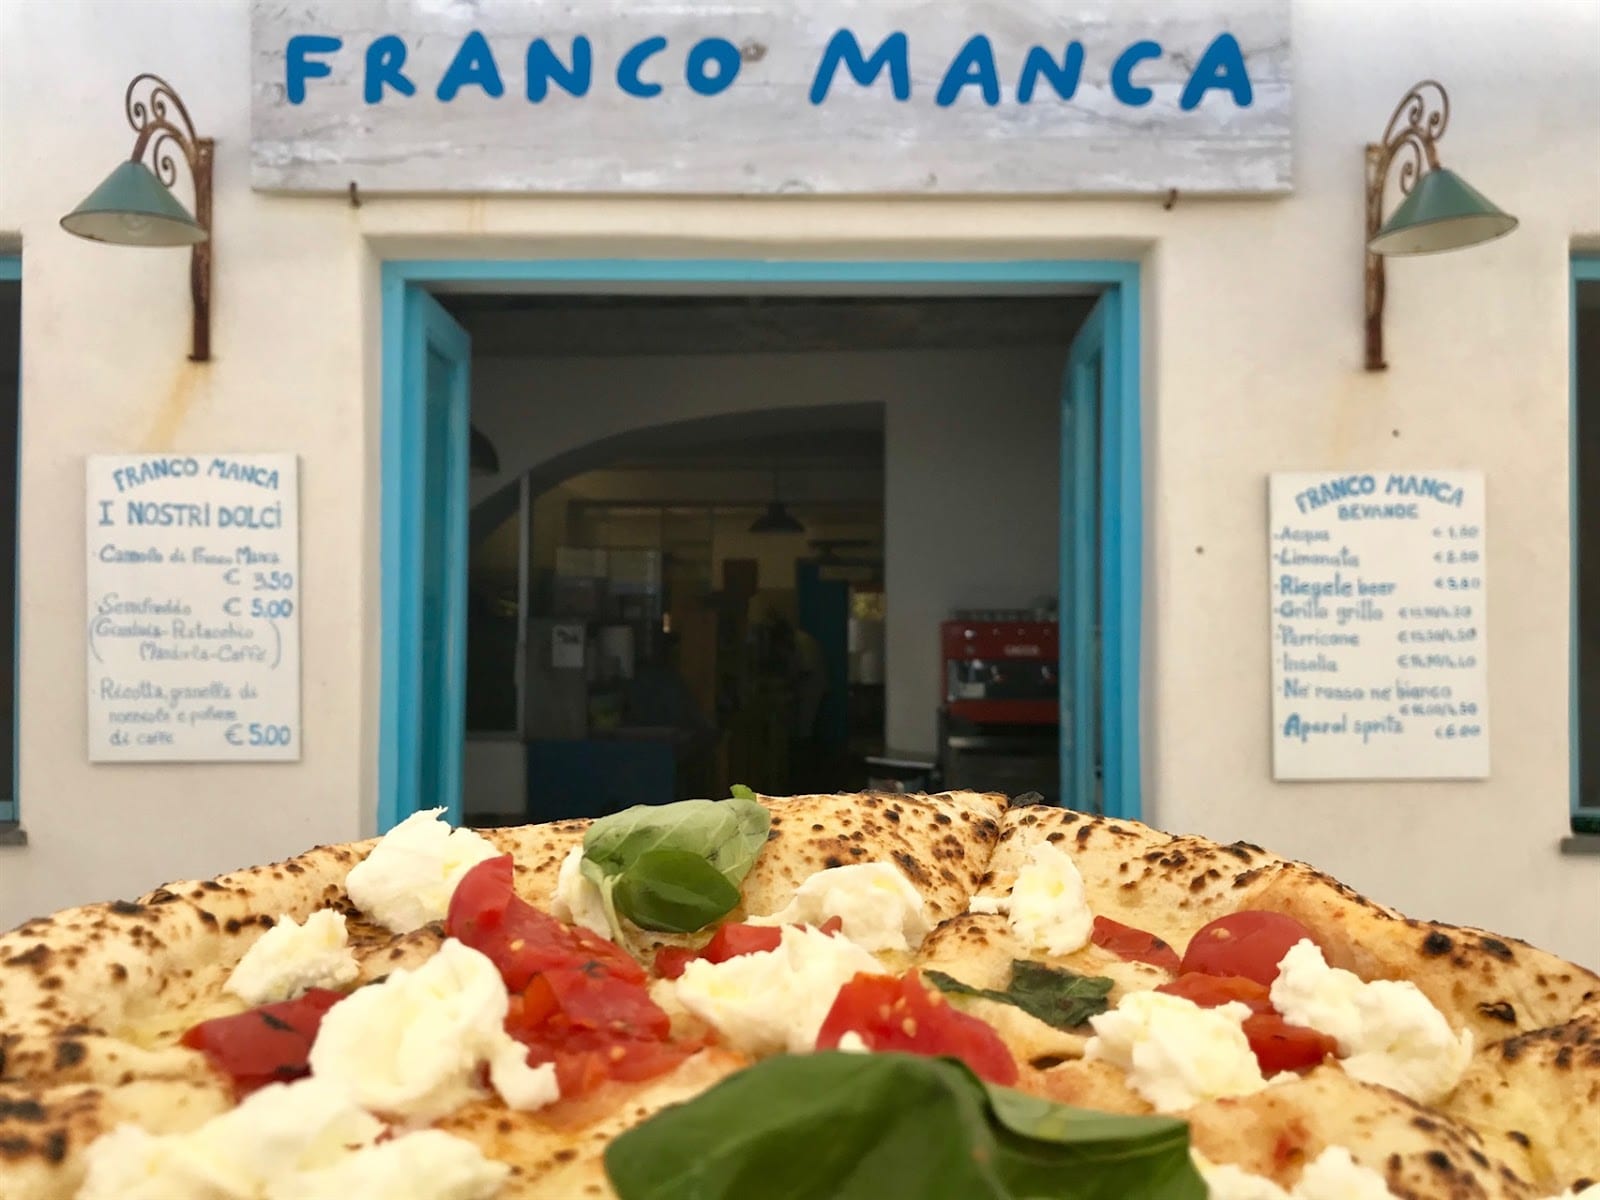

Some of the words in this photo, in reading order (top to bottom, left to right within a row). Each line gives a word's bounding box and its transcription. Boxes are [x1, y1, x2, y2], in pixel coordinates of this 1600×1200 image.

[285, 30, 743, 105] FRANCO
[809, 29, 1254, 110] MANCA
[113, 458, 199, 492] FRANCO
[207, 459, 279, 490] MANCA
[1295, 475, 1376, 514] FRANCO
[1385, 474, 1464, 507] MANCA
[99, 501, 114, 526] I
[127, 501, 210, 527] NOSTRI
[218, 501, 281, 529] DOLCI
[1337, 504, 1420, 520] BEVANDE
[1279, 546, 1360, 567] Limonata
[1357, 577, 1396, 596] beer
[251, 598, 294, 618] 5.00
[1336, 599, 1384, 625] grillo
[1283, 712, 1347, 743] Aperol
